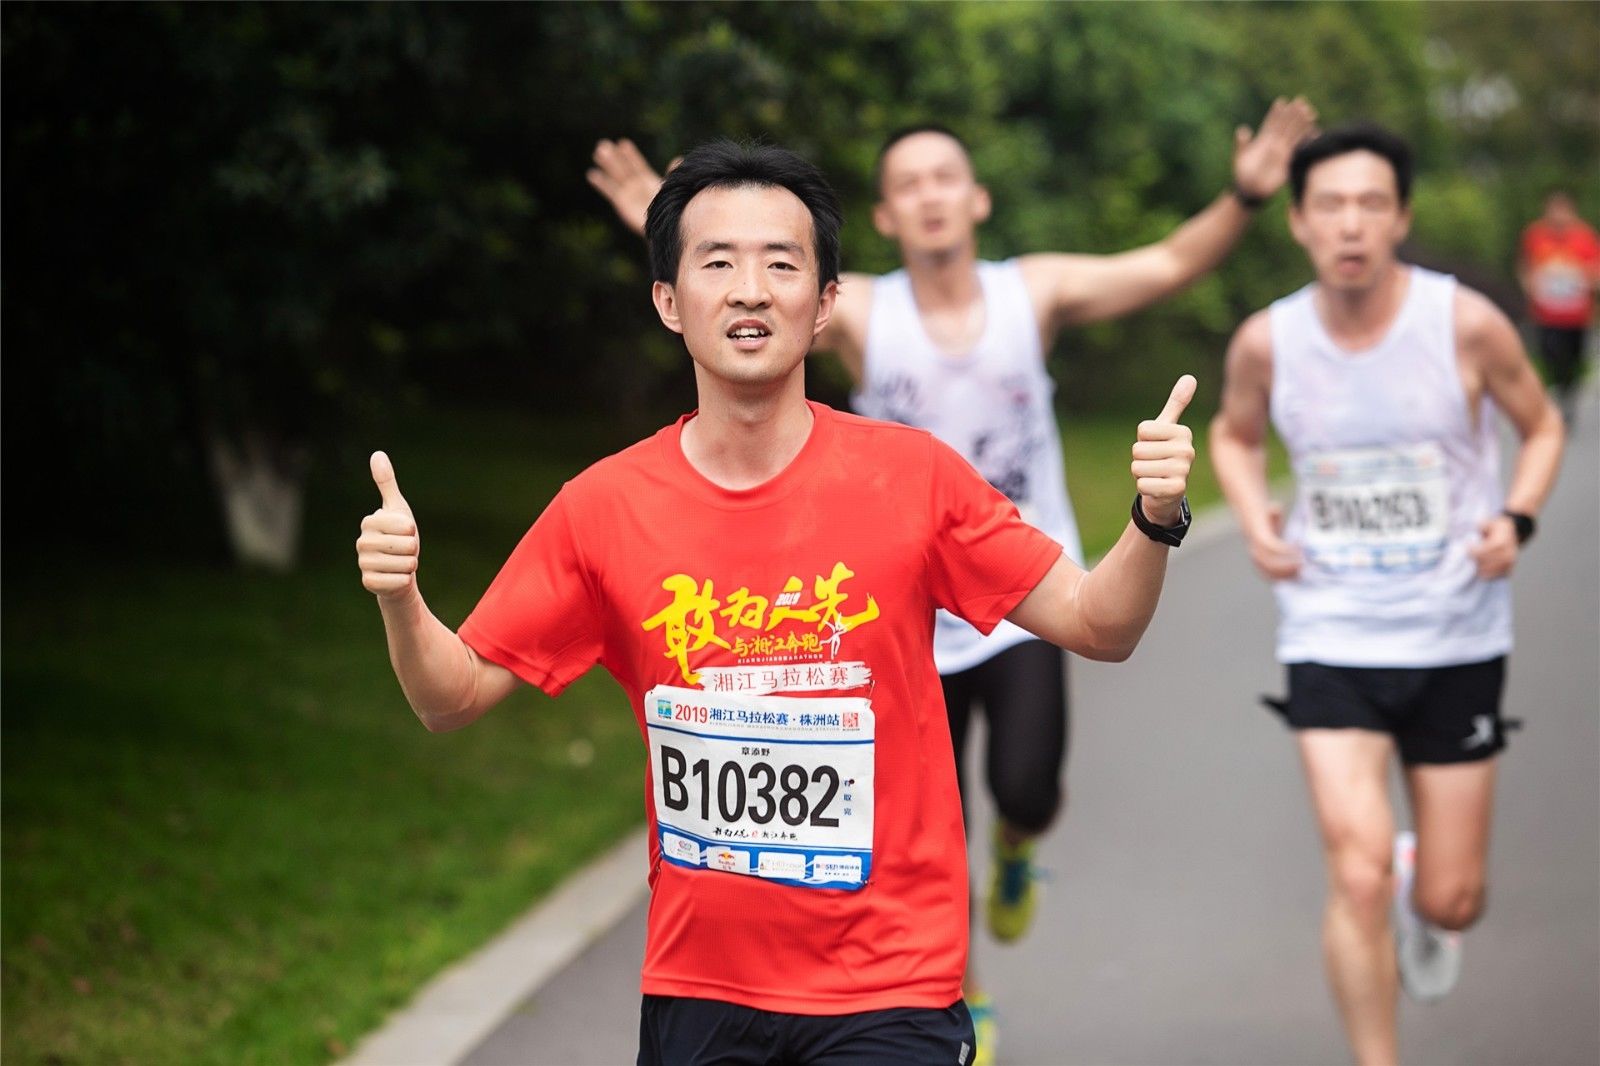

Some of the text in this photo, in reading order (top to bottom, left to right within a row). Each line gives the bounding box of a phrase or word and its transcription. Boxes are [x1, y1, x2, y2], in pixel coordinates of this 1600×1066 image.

[774, 591, 801, 607] 2019
[641, 561, 880, 685] 敢为人先
[713, 666, 850, 693] 湘江马拉松赛
[675, 703, 708, 724] 2019
[660, 745, 840, 828] B10382
